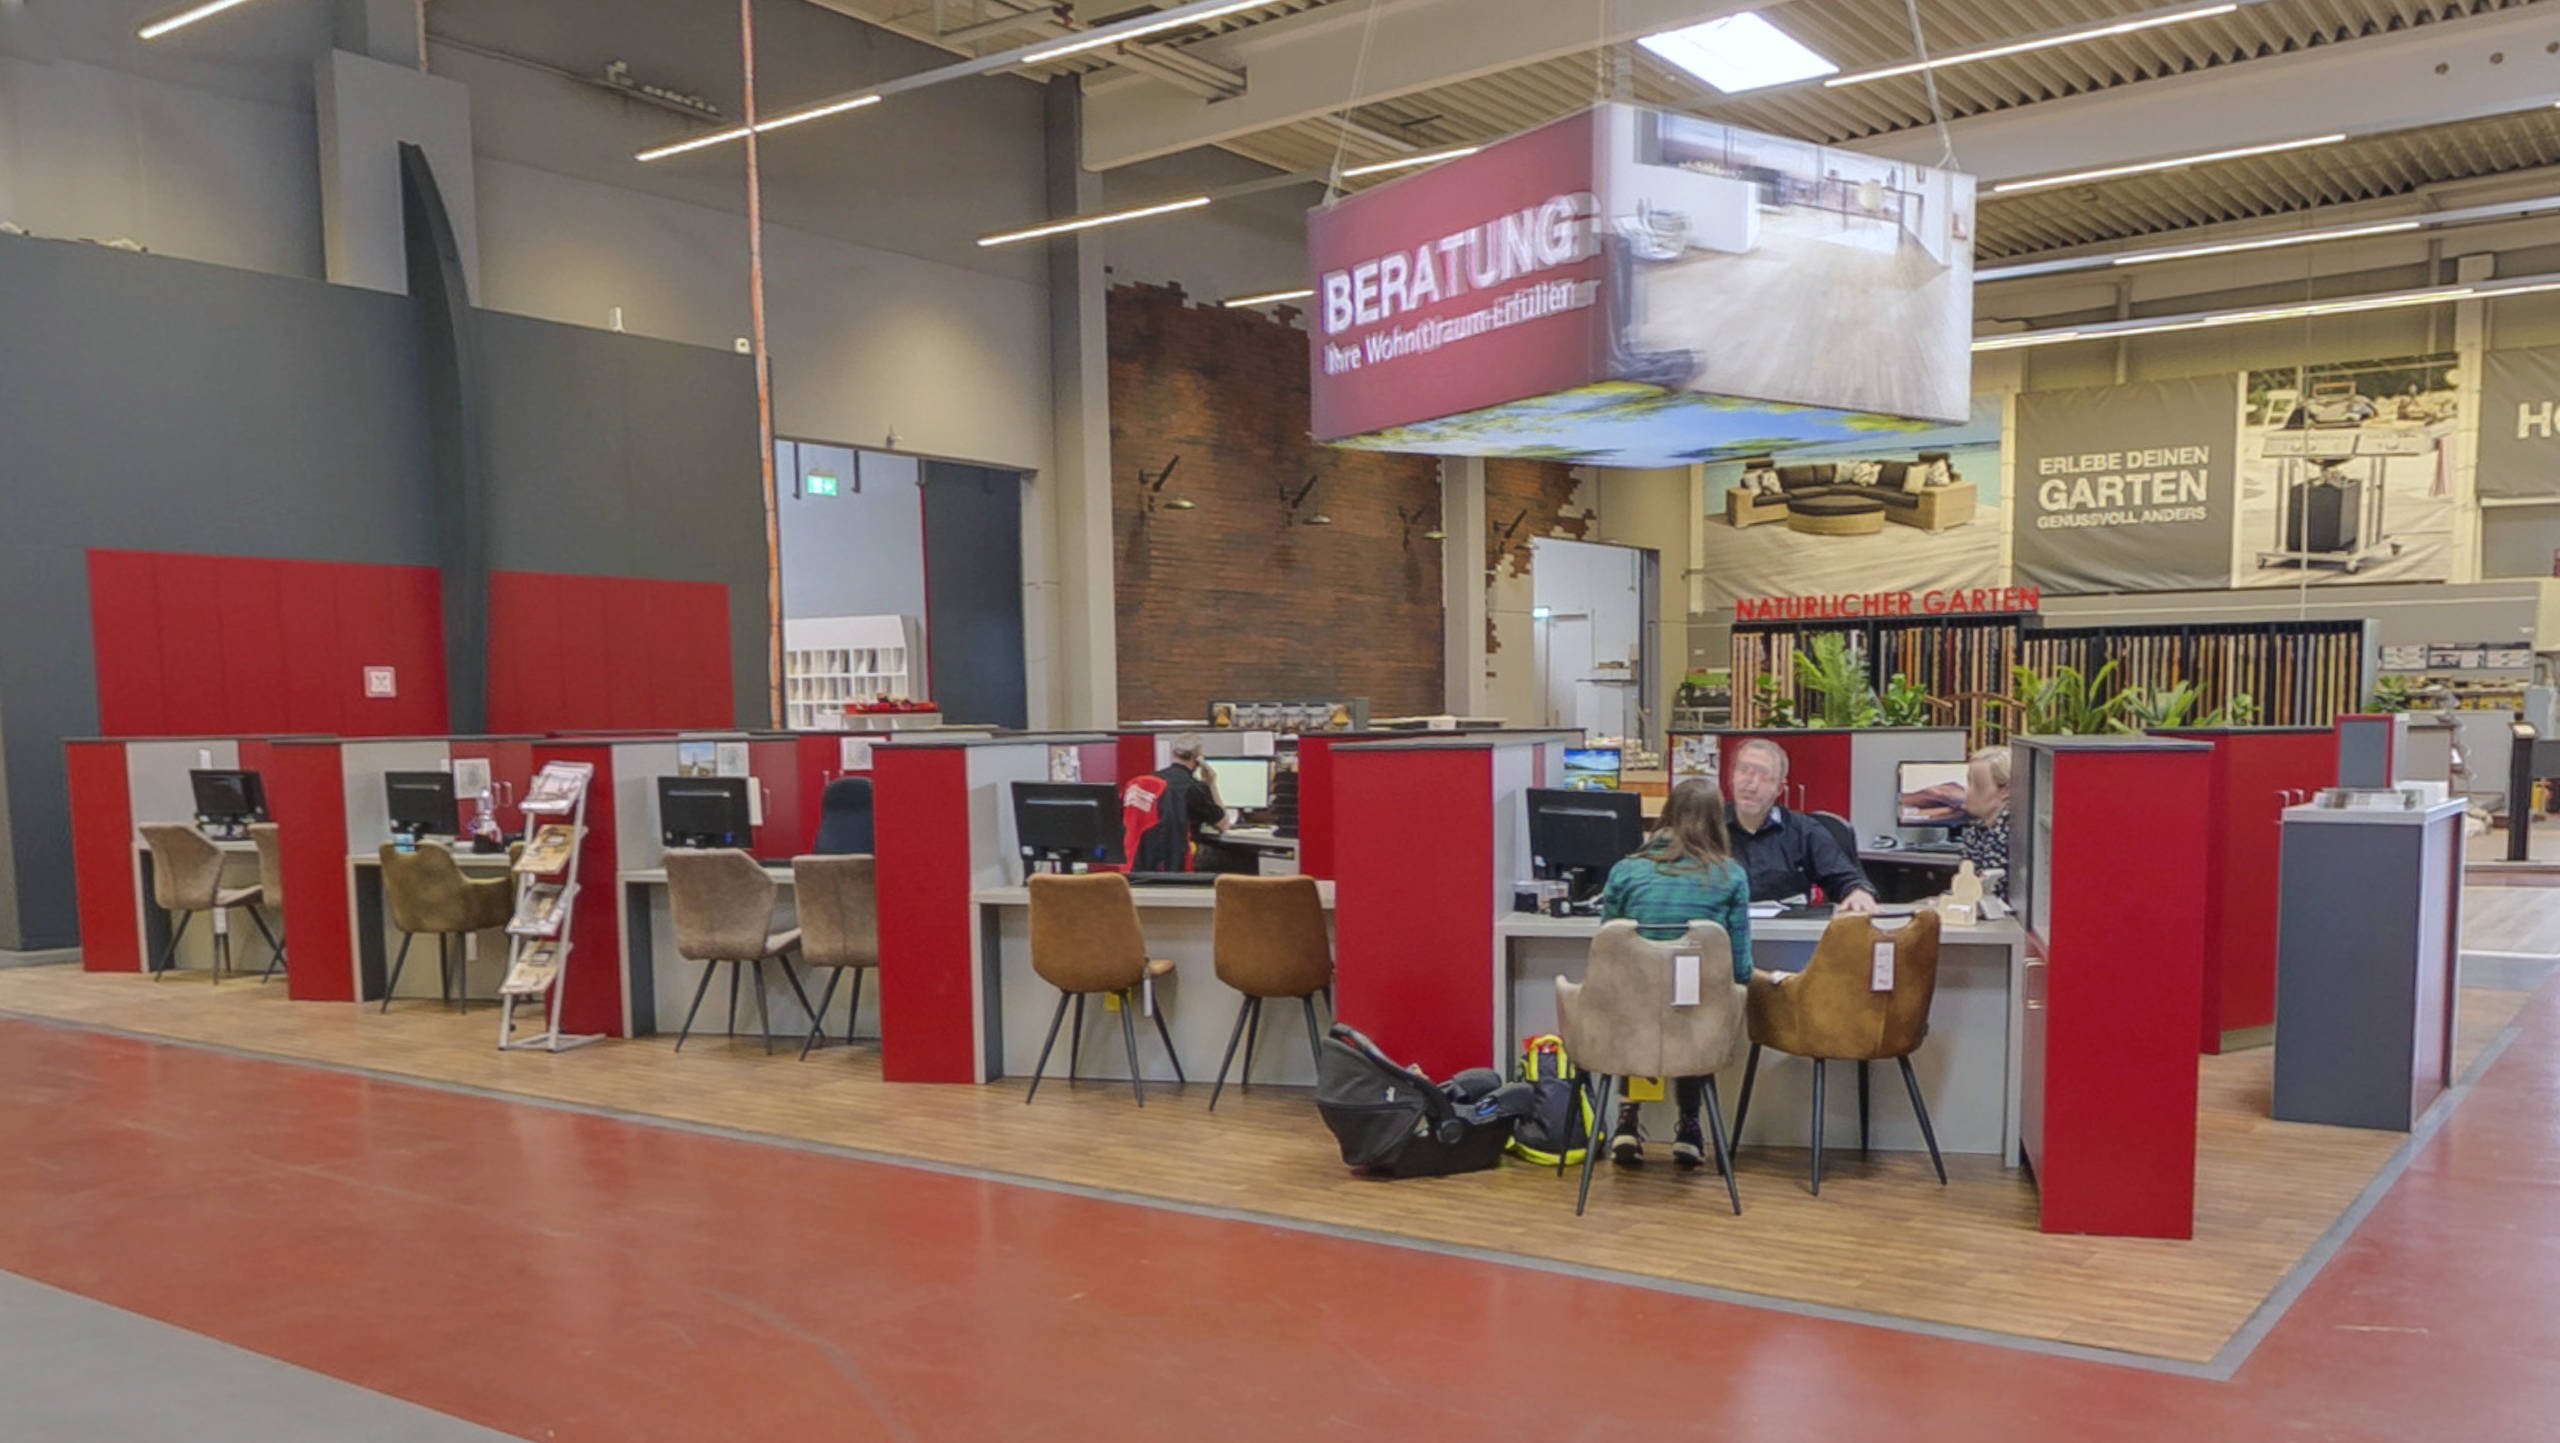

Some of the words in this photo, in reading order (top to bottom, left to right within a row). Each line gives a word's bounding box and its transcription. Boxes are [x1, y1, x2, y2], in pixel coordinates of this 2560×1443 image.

[1322, 192, 1600, 335] BERATUNG
[1323, 341, 1362, 375] Ihre
[2518, 401, 2560, 439] H
[2039, 452, 2122, 475] ERLEBE
[2127, 445, 2209, 470] DEINEN
[2038, 469, 2208, 511] GARTEN
[2037, 510, 2137, 529] GENUSSVOLL
[2141, 506, 2207, 523] ANDERS
[1922, 585, 2039, 615] GARTEN
